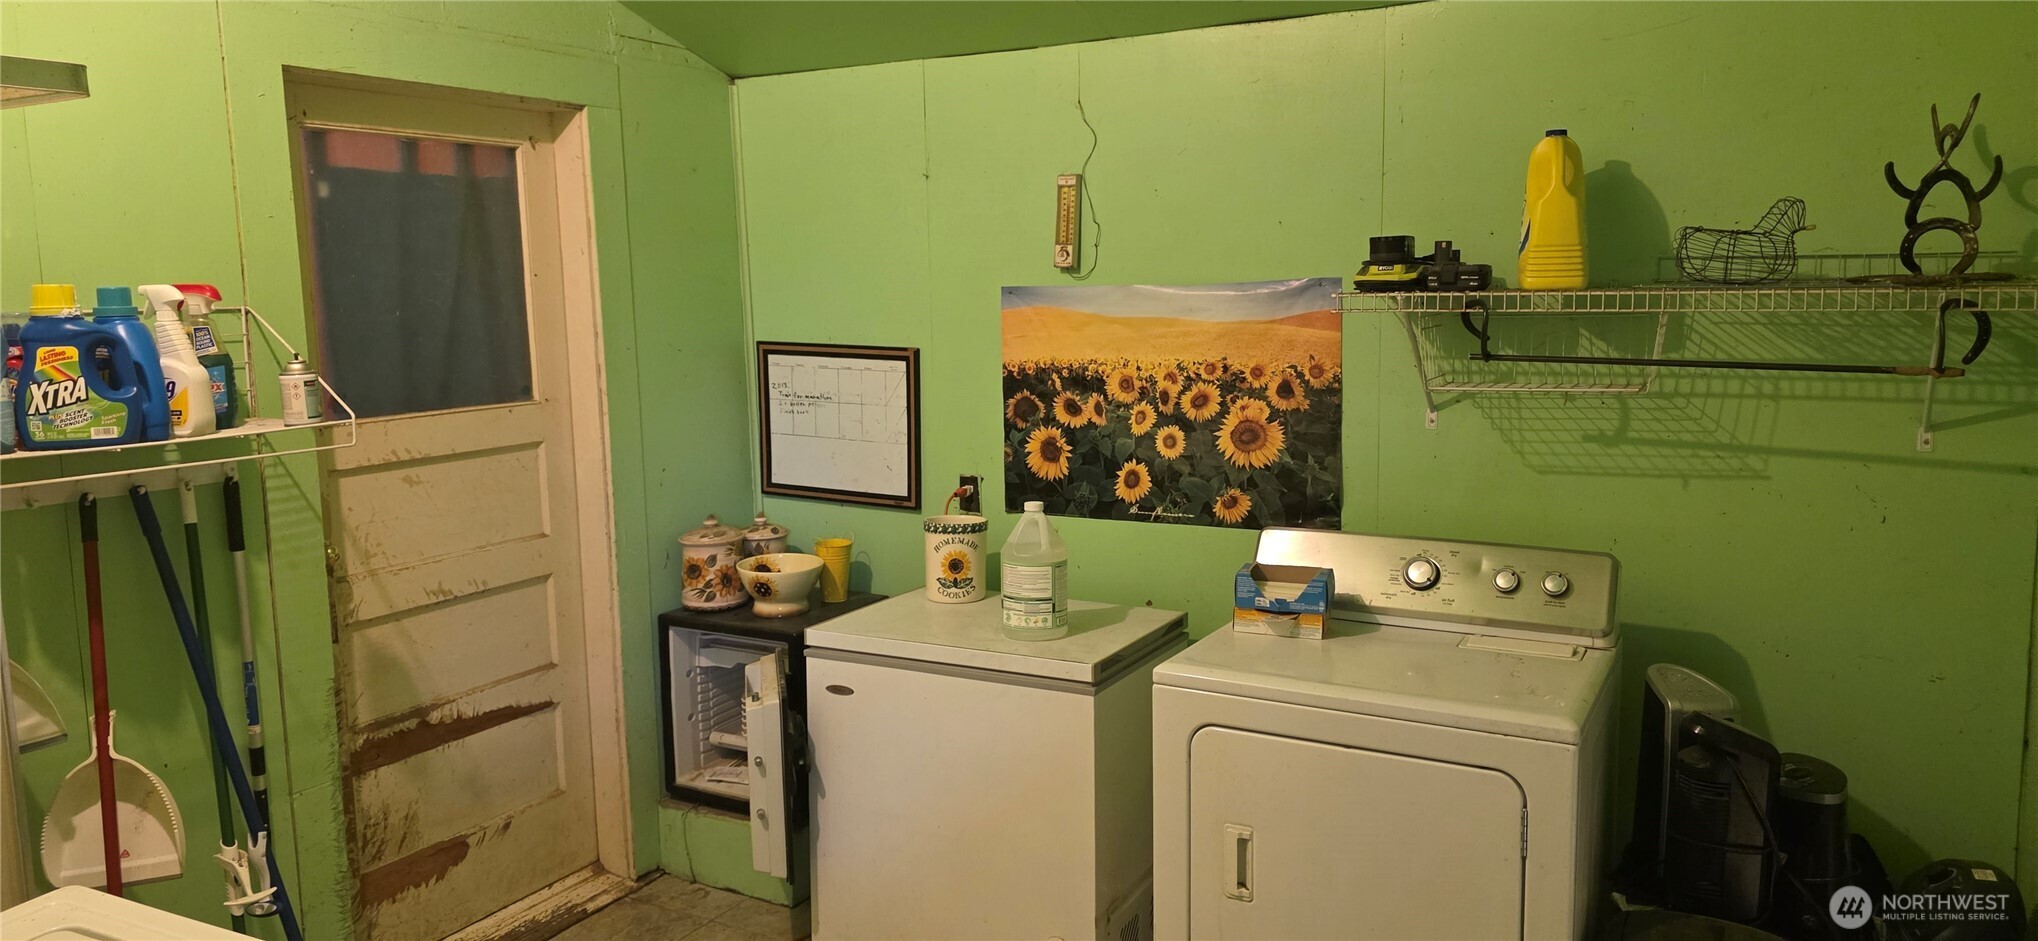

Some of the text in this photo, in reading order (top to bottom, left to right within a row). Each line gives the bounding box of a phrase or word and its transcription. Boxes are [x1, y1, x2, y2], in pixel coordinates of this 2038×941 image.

[40, 350, 67, 363] LASTING
[27, 376, 88, 416] XTRA
[59, 412, 89, 424] BOOSTER
[65, 408, 85, 417] SCENT
[53, 416, 94, 430] TECHNOLOGY
[933, 537, 979, 553] HOMEMADE
[937, 585, 976, 599] COOKIES
